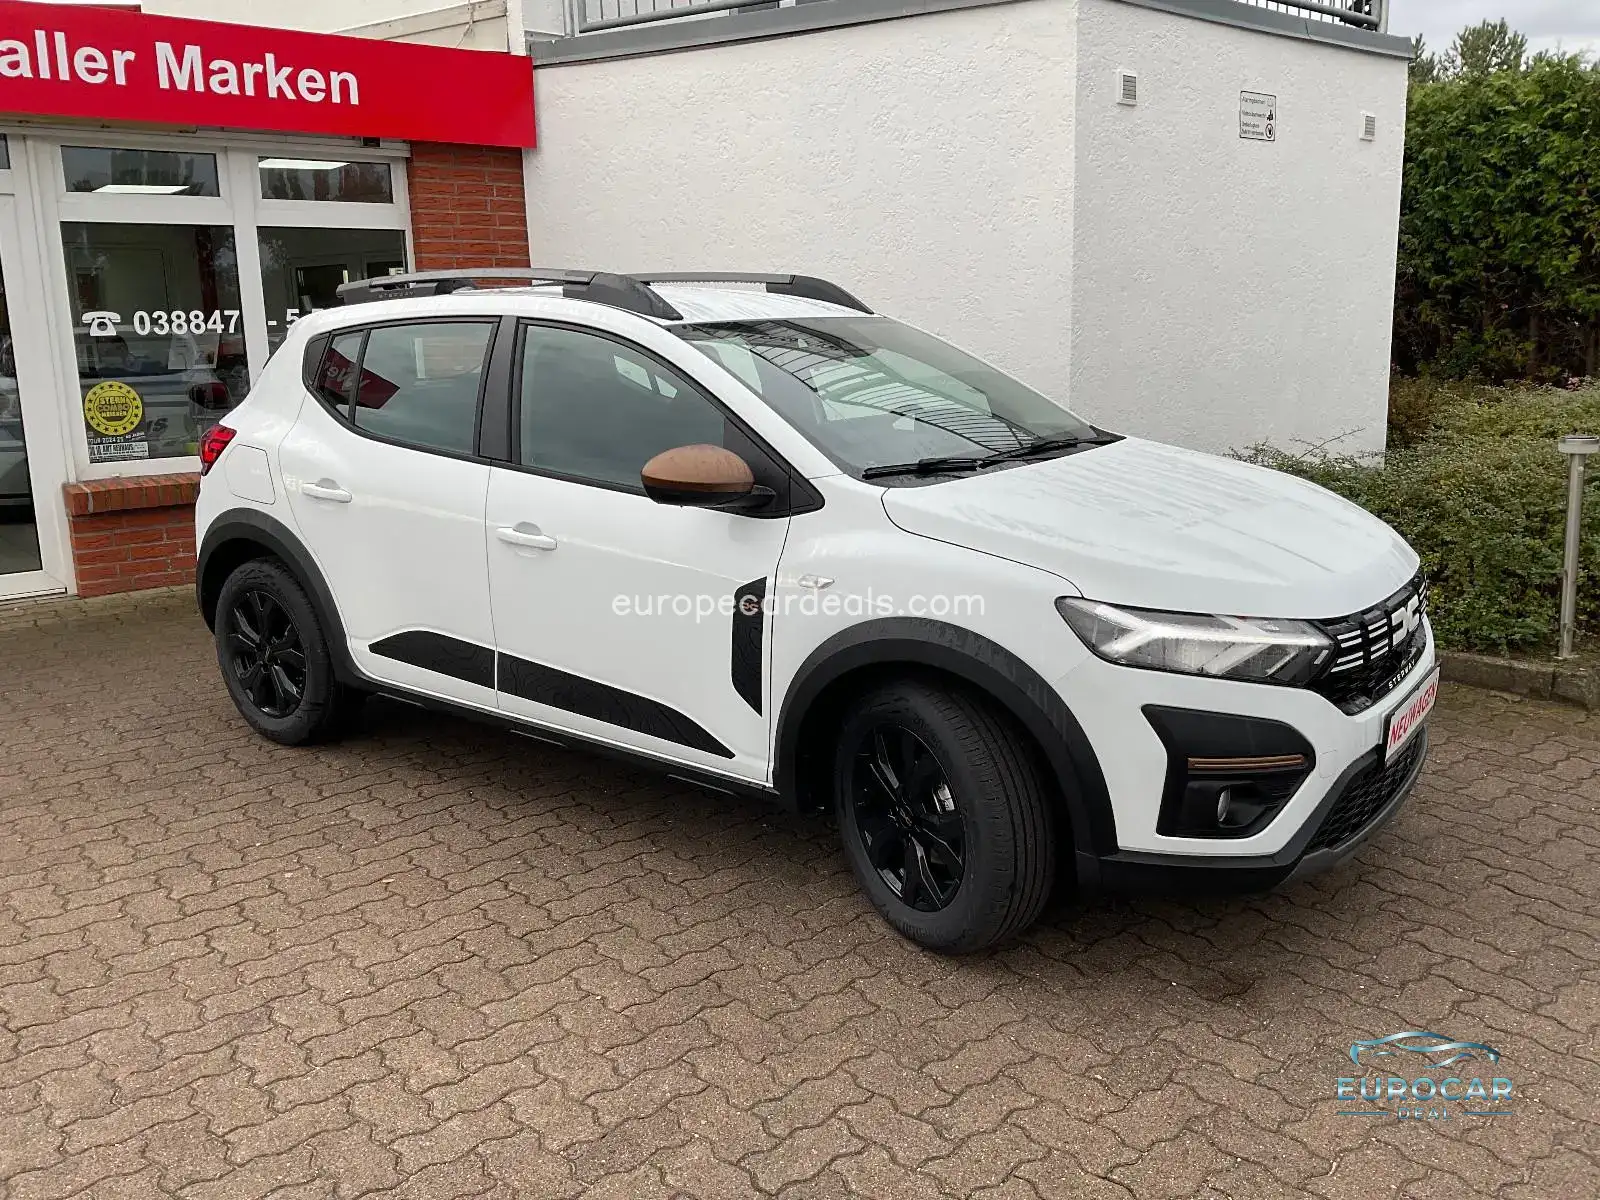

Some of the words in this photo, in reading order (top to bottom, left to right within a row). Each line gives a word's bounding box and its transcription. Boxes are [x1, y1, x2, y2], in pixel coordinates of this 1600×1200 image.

[0, 29, 136, 85] aller
[155, 41, 359, 106] Marken
[133, 310, 240, 336] 038847
[1388, 659, 1415, 690] STEPWAY
